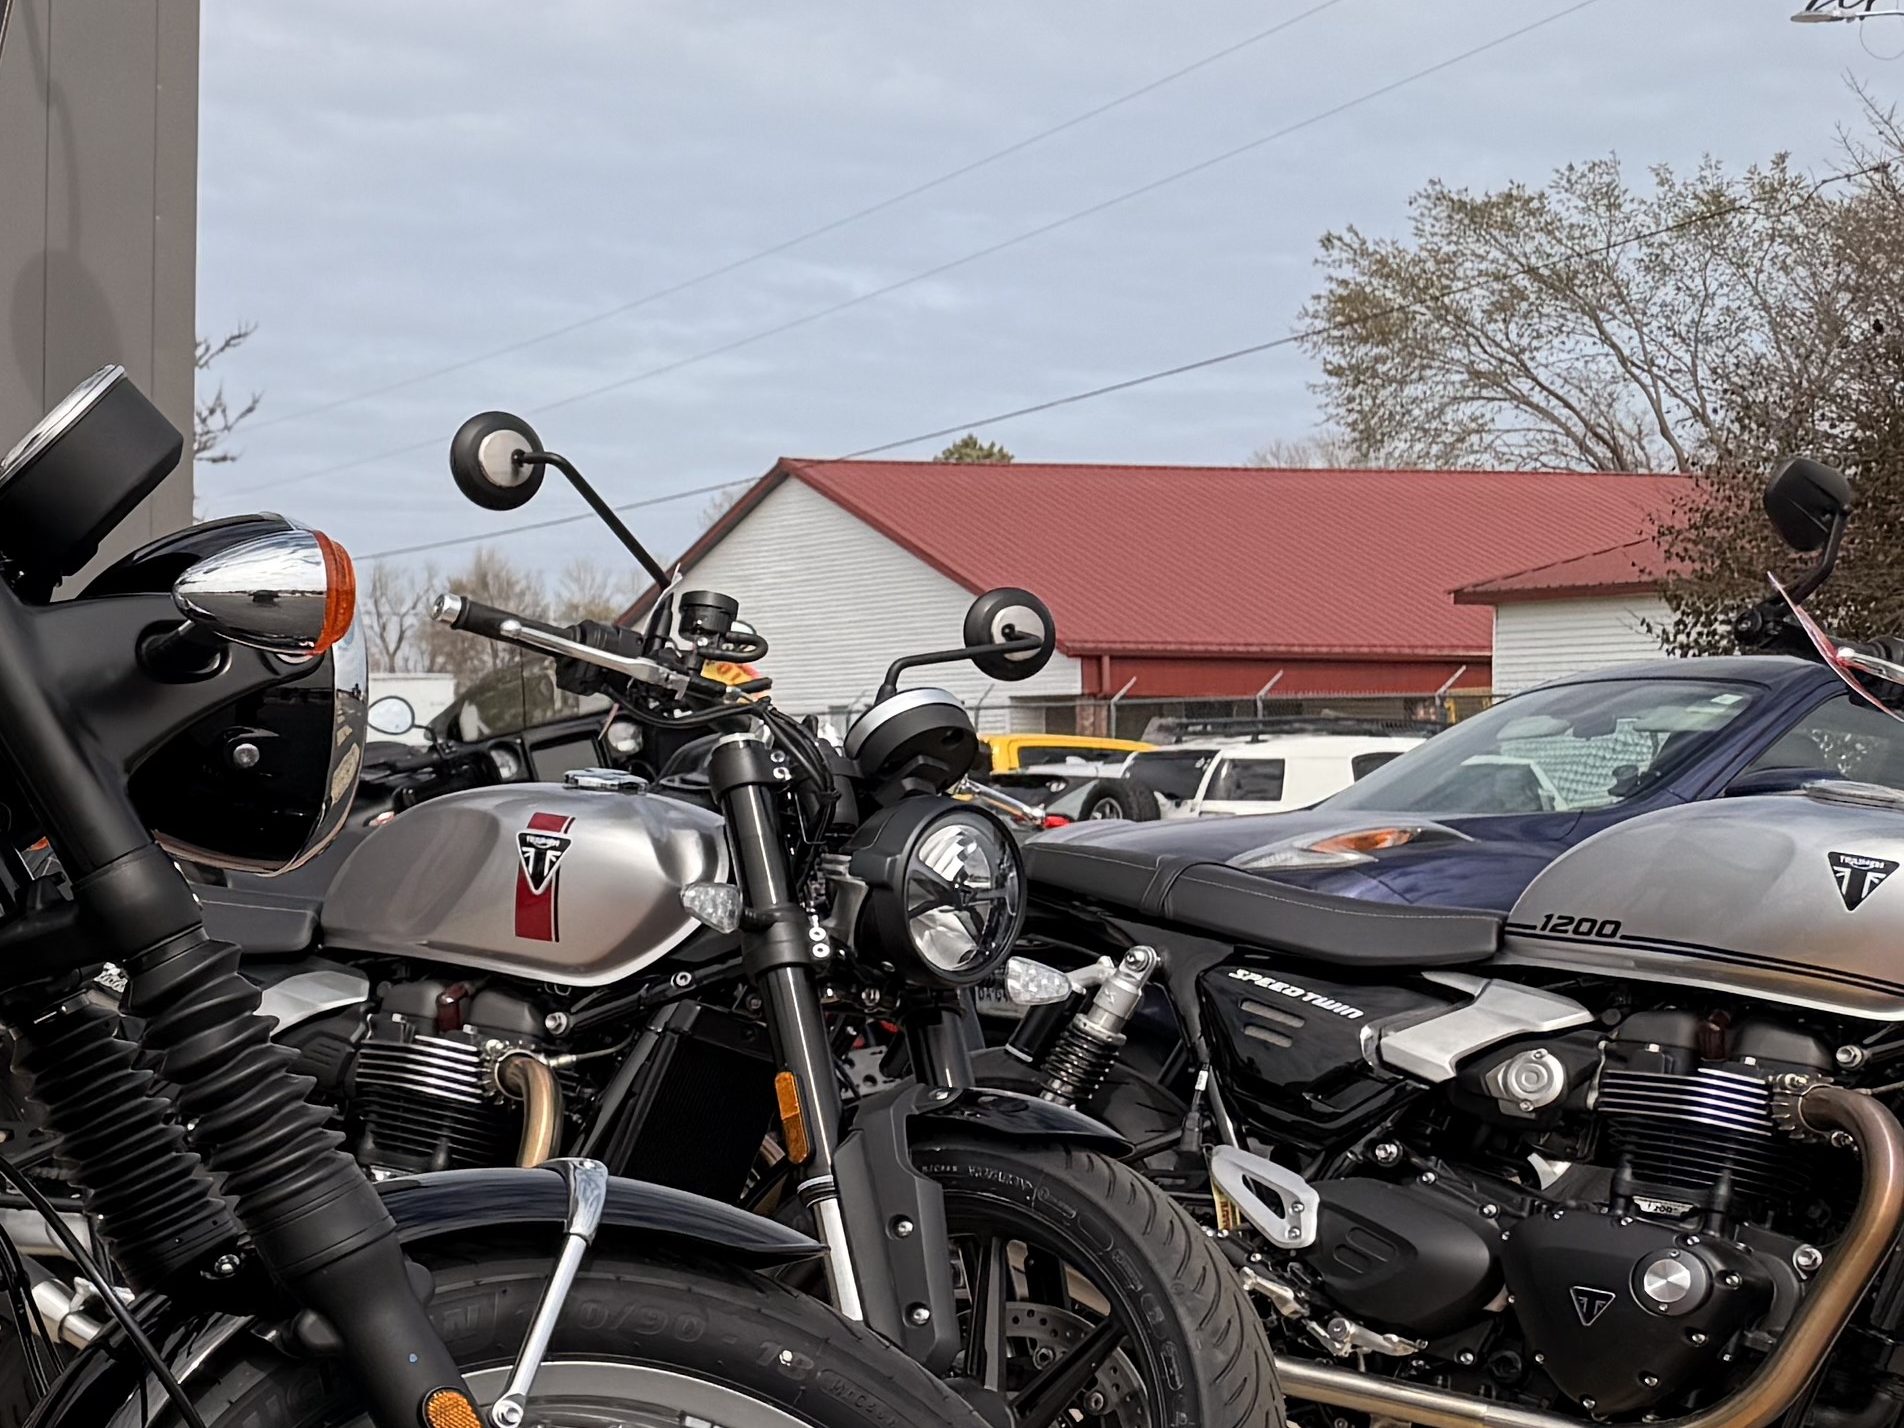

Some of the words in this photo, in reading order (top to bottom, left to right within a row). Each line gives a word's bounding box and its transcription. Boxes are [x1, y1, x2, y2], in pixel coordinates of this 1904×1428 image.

[1540, 913, 1622, 939] 1200
[1228, 968, 1305, 997] SPEED
[1302, 991, 1364, 1019] TWIN
